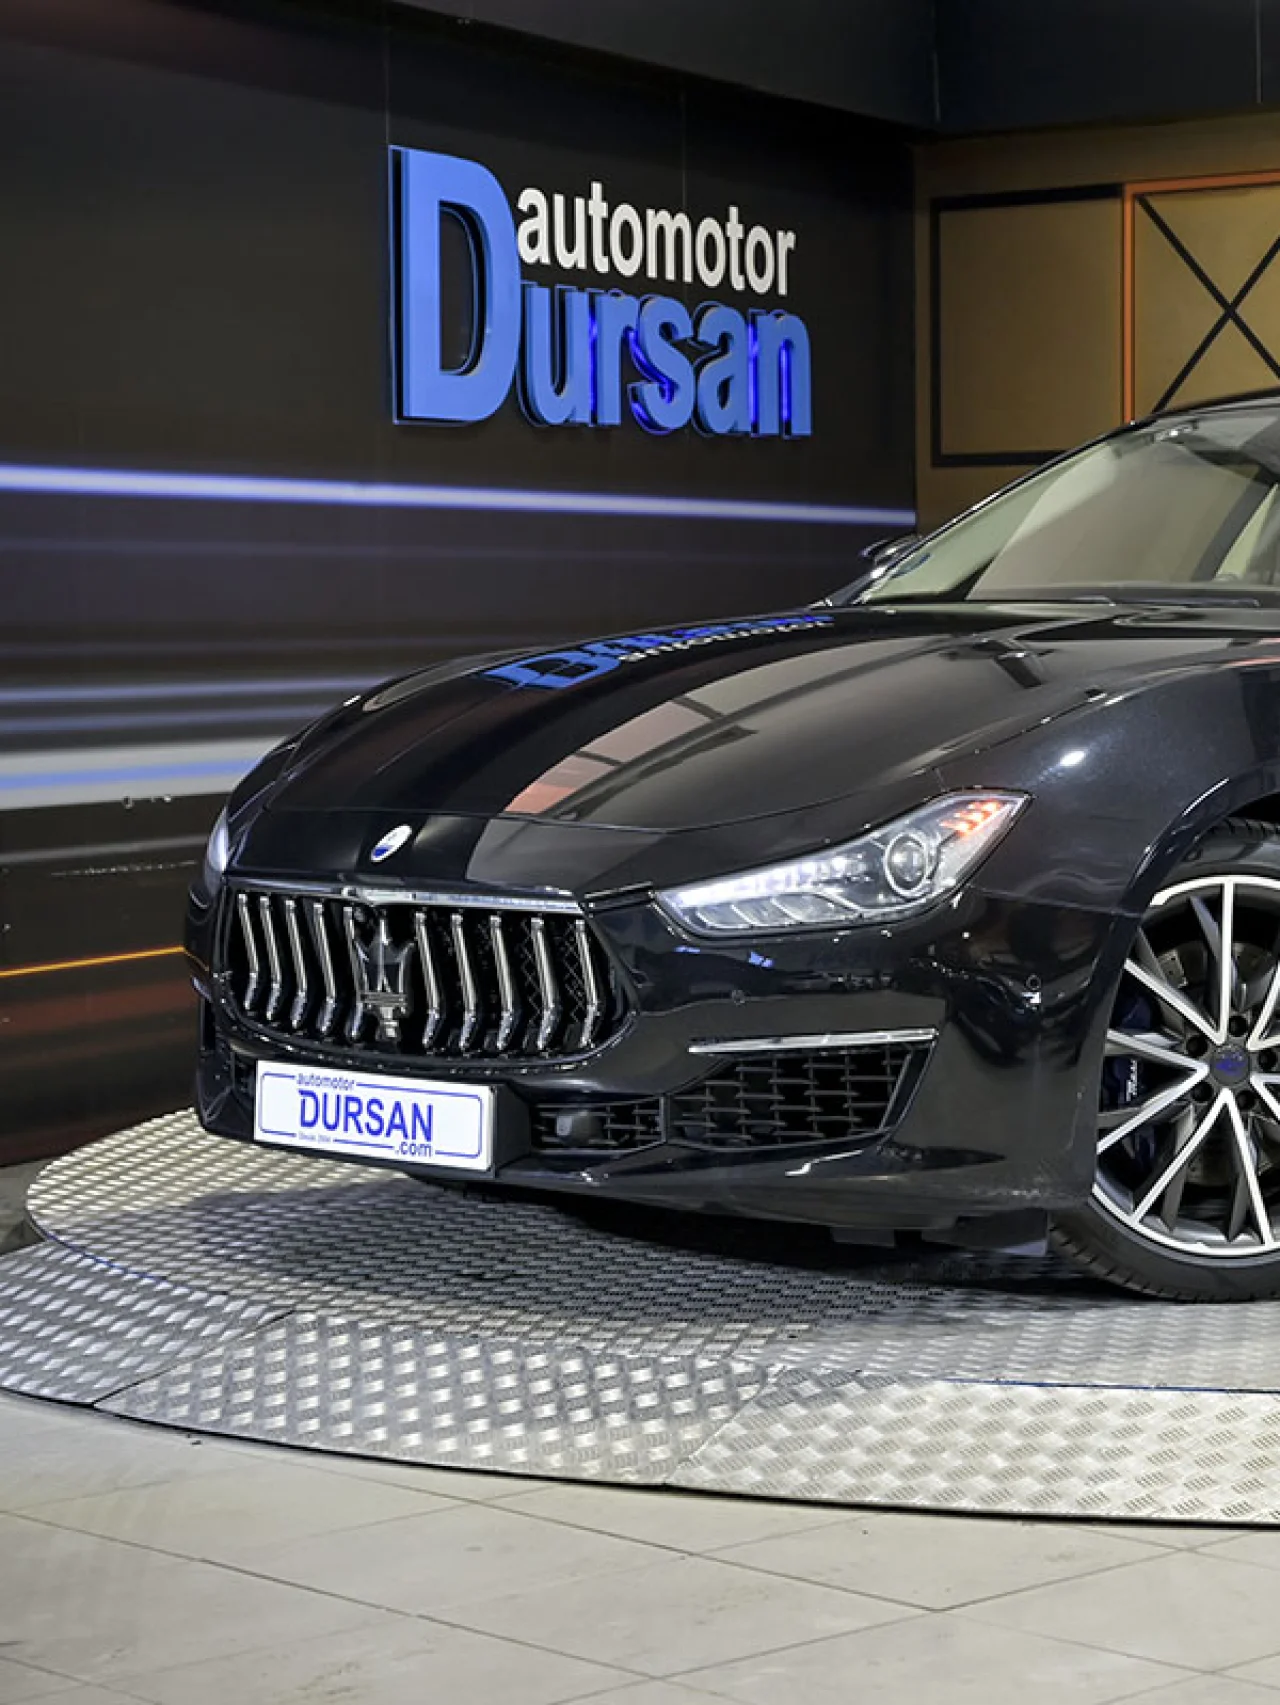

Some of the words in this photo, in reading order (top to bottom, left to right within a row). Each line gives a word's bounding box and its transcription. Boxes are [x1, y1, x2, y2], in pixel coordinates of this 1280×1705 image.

[517, 182, 796, 296] automotor
[389, 144, 812, 438] Dursan
[296, 1073, 356, 1091] automotor
[298, 1089, 434, 1142] DURSAN
[394, 1141, 432, 1158] .com
